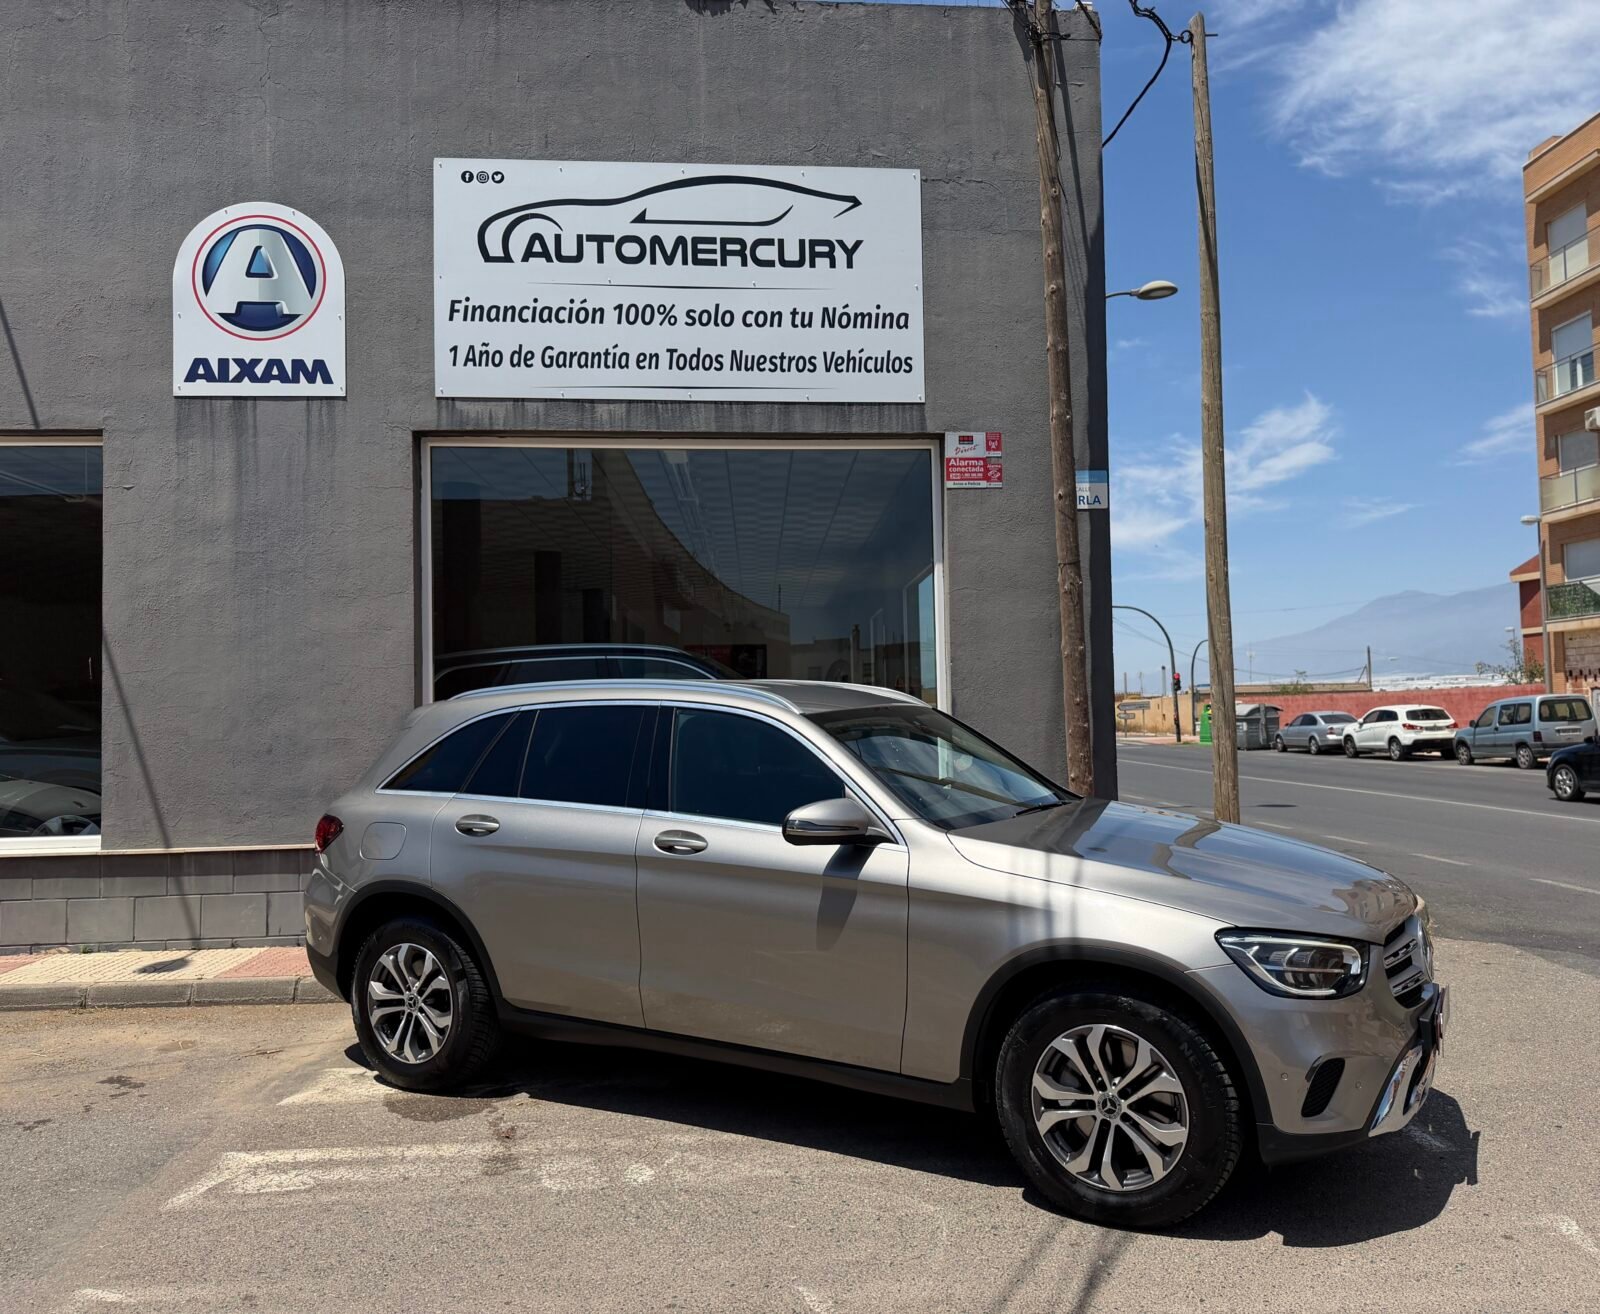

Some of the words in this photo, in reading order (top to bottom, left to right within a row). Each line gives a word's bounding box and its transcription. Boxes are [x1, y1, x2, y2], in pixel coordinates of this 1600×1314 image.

[520, 232, 863, 270] AUTOMERCURY
[449, 297, 605, 325] Financiación
[613, 303, 678, 327] 100%
[684, 303, 735, 328] solo
[741, 311, 783, 329] con
[789, 307, 814, 329] tu
[820, 304, 910, 330] Nómina
[183, 357, 334, 385] AIXAM
[449, 345, 459, 367] 1
[463, 342, 504, 368] Año
[509, 344, 535, 369] de
[540, 344, 630, 370] Garantía
[635, 353, 660, 370] en
[666, 347, 724, 372] Todos
[730, 350, 817, 374] Nuestros
[822, 348, 913, 374] Vehículos
[949, 458, 984, 466] Alarma
[1078, 495, 1102, 505] RLA
